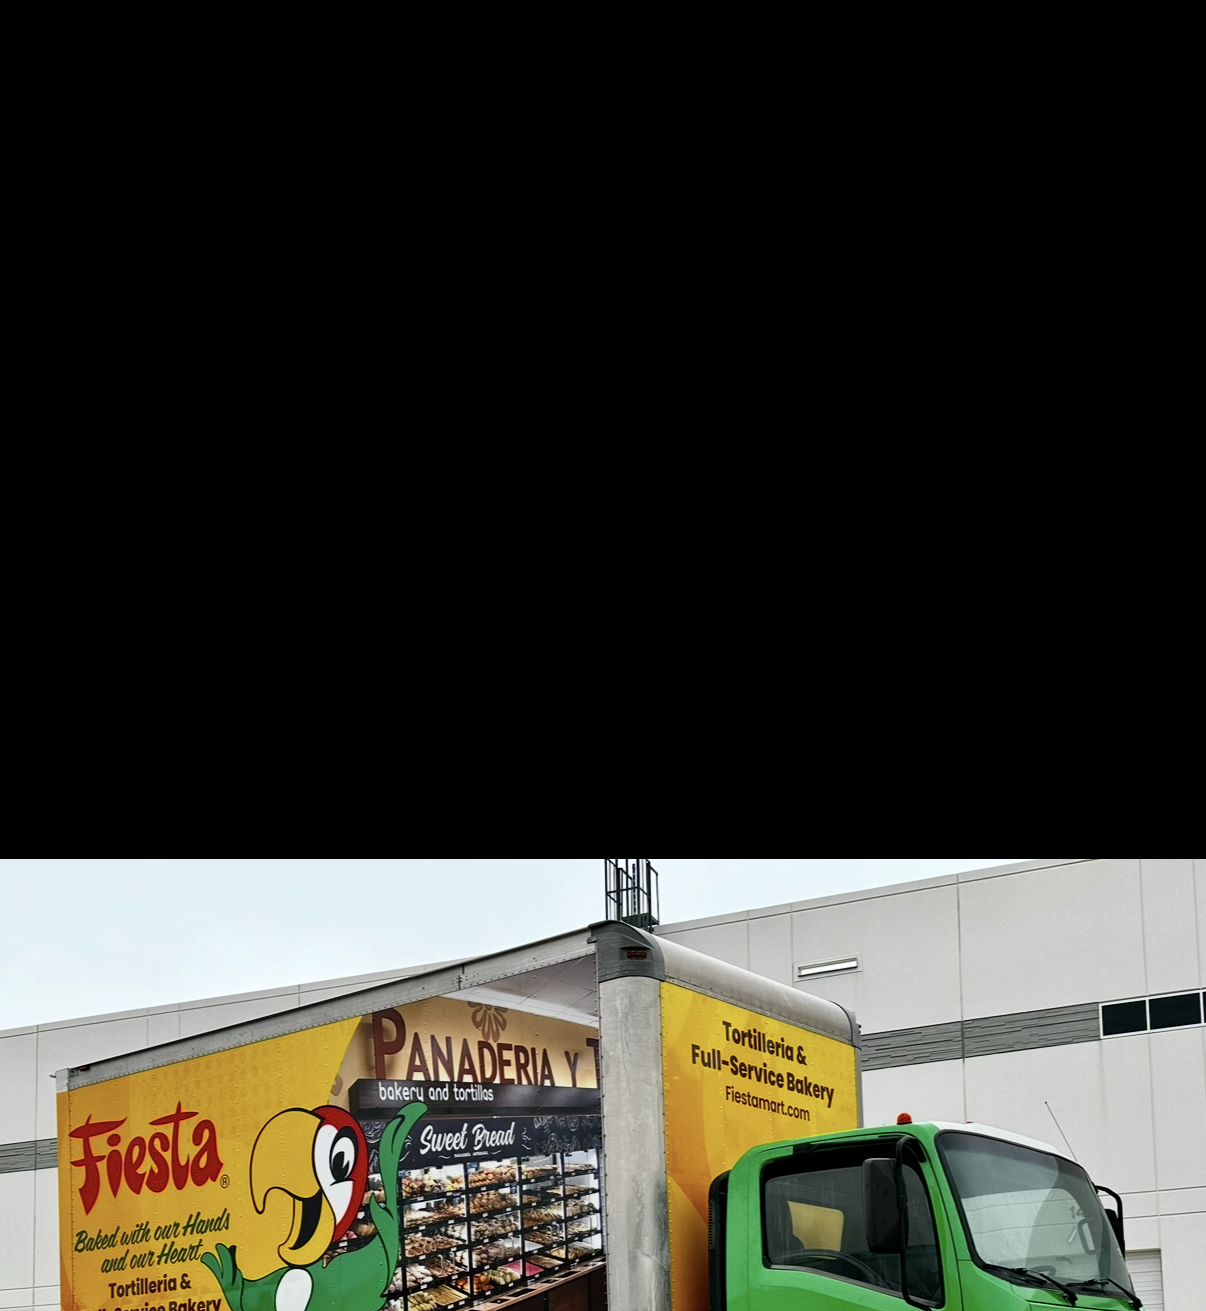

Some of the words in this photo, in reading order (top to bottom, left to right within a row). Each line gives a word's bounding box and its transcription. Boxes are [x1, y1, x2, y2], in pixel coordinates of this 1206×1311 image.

[371, 1007, 556, 1087] PANADERIA
[722, 1020, 794, 1062] Tortilleria
[796, 1045, 808, 1066] &
[378, 1081, 424, 1102] bakery
[428, 1083, 449, 1101] and
[453, 1083, 494, 1101] tortillas
[691, 1043, 785, 1089] Full-Service
[786, 1071, 835, 1109] Bakery
[725, 1085, 811, 1122] Fiestamart.com
[68, 1100, 224, 1216] Fiesta
[419, 1122, 468, 1155] Sweet
[471, 1121, 516, 1151] Bread
[74, 1225, 120, 1253] Baked
[120, 1220, 151, 1246] with
[153, 1221, 180, 1241] our
[182, 1207, 230, 1237] Hands
[101, 1248, 130, 1273] and
[129, 1250, 155, 1269] our
[157, 1238, 203, 1265] Heart
[108, 1273, 177, 1299] Tortilleria
[180, 1272, 192, 1290] &
